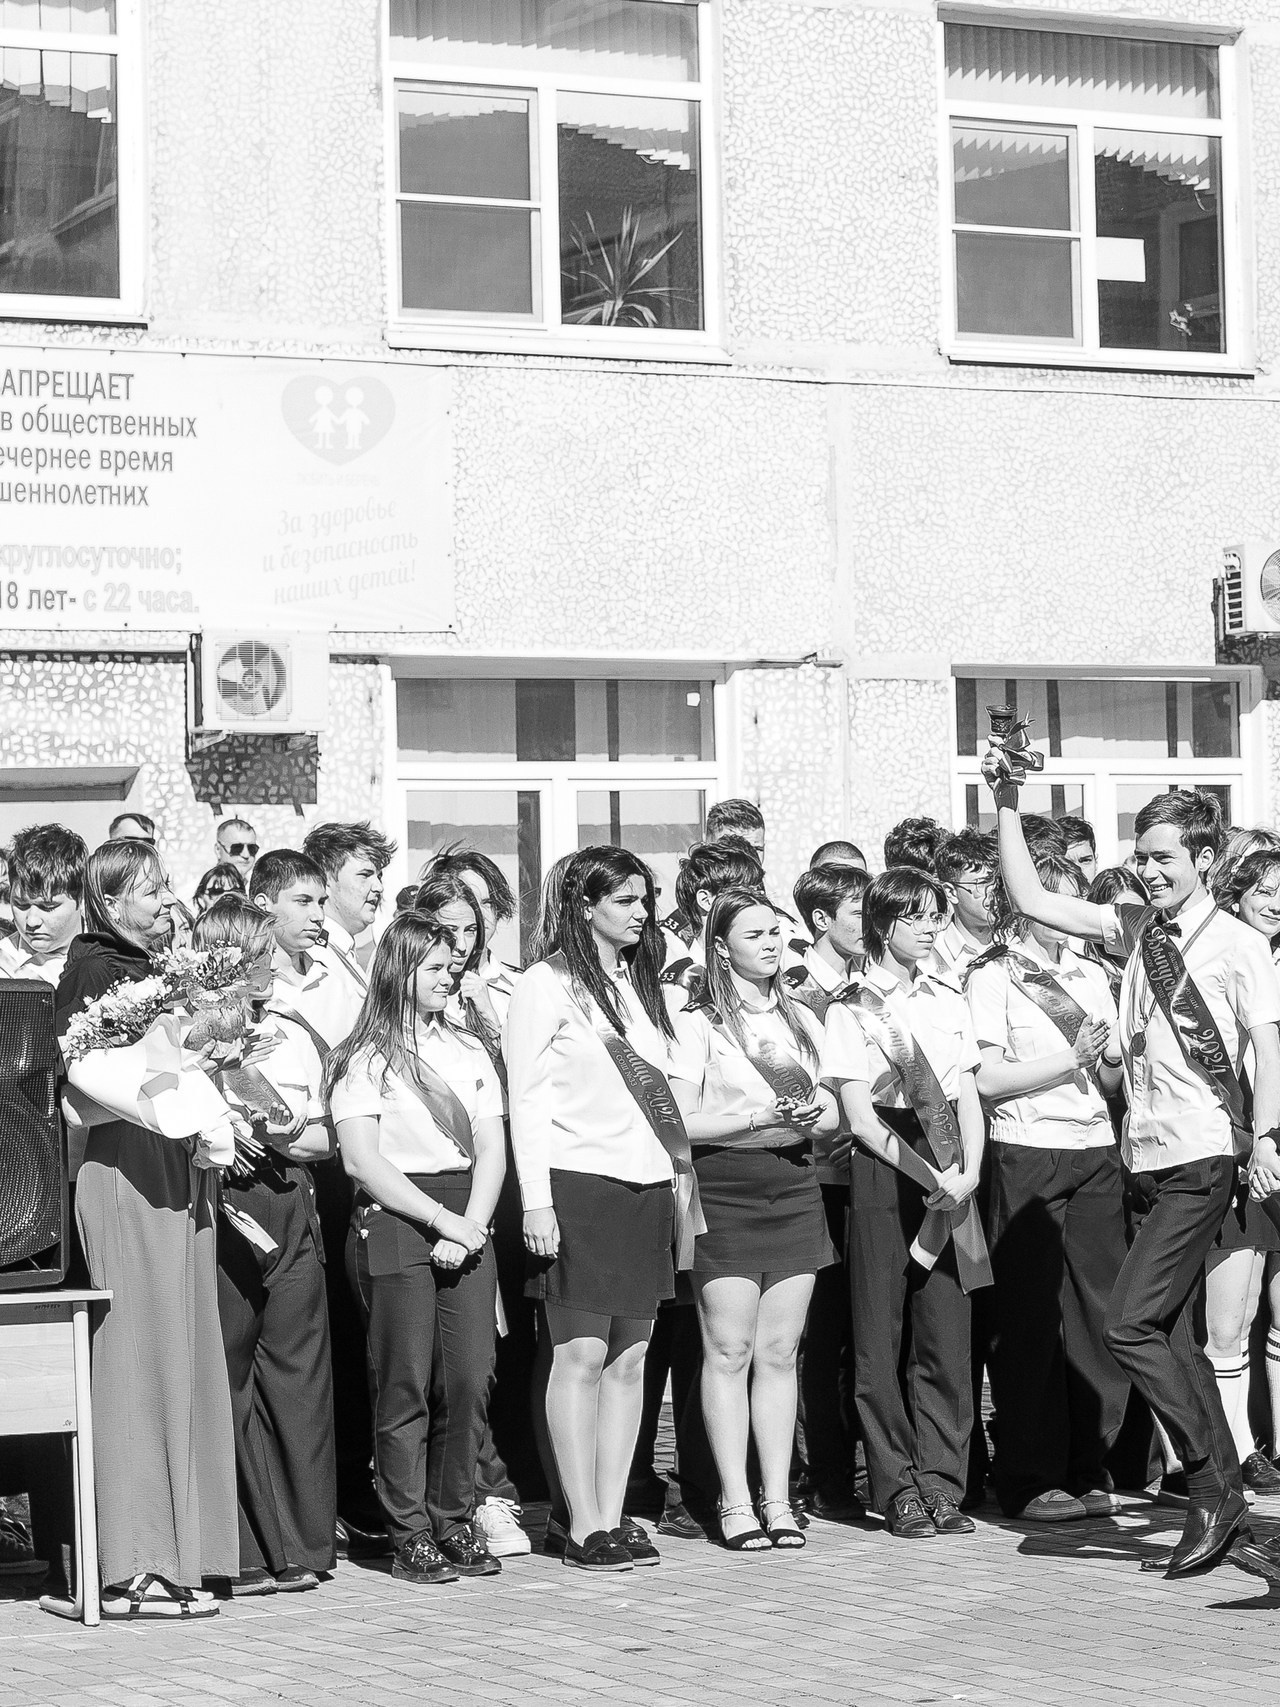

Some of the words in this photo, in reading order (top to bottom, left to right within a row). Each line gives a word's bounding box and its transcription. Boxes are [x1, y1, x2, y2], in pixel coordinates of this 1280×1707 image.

[0, 368, 135, 404] АПРЕЩАЕТ
[1, 411, 13, 432] в
[21, 404, 198, 439] общественных
[99, 449, 174, 478] время
[0, 481, 149, 508] шеннолетних
[277, 510, 304, 536] За
[309, 494, 398, 538] здоровье
[262, 553, 276, 574] и
[280, 531, 419, 574] безопасность
[26, 589, 77, 613] лет-
[83, 590, 98, 612] с
[103, 581, 132, 613] 22
[137, 590, 201, 614] часа.
[274, 575, 344, 606] наших
[348, 557, 416, 601] детей!
[661, 972, 676, 982] 33
[1189, 1028, 1230, 1076] 2024
[645, 1087, 681, 1125] 2024
[924, 1101, 959, 1145] 2024
